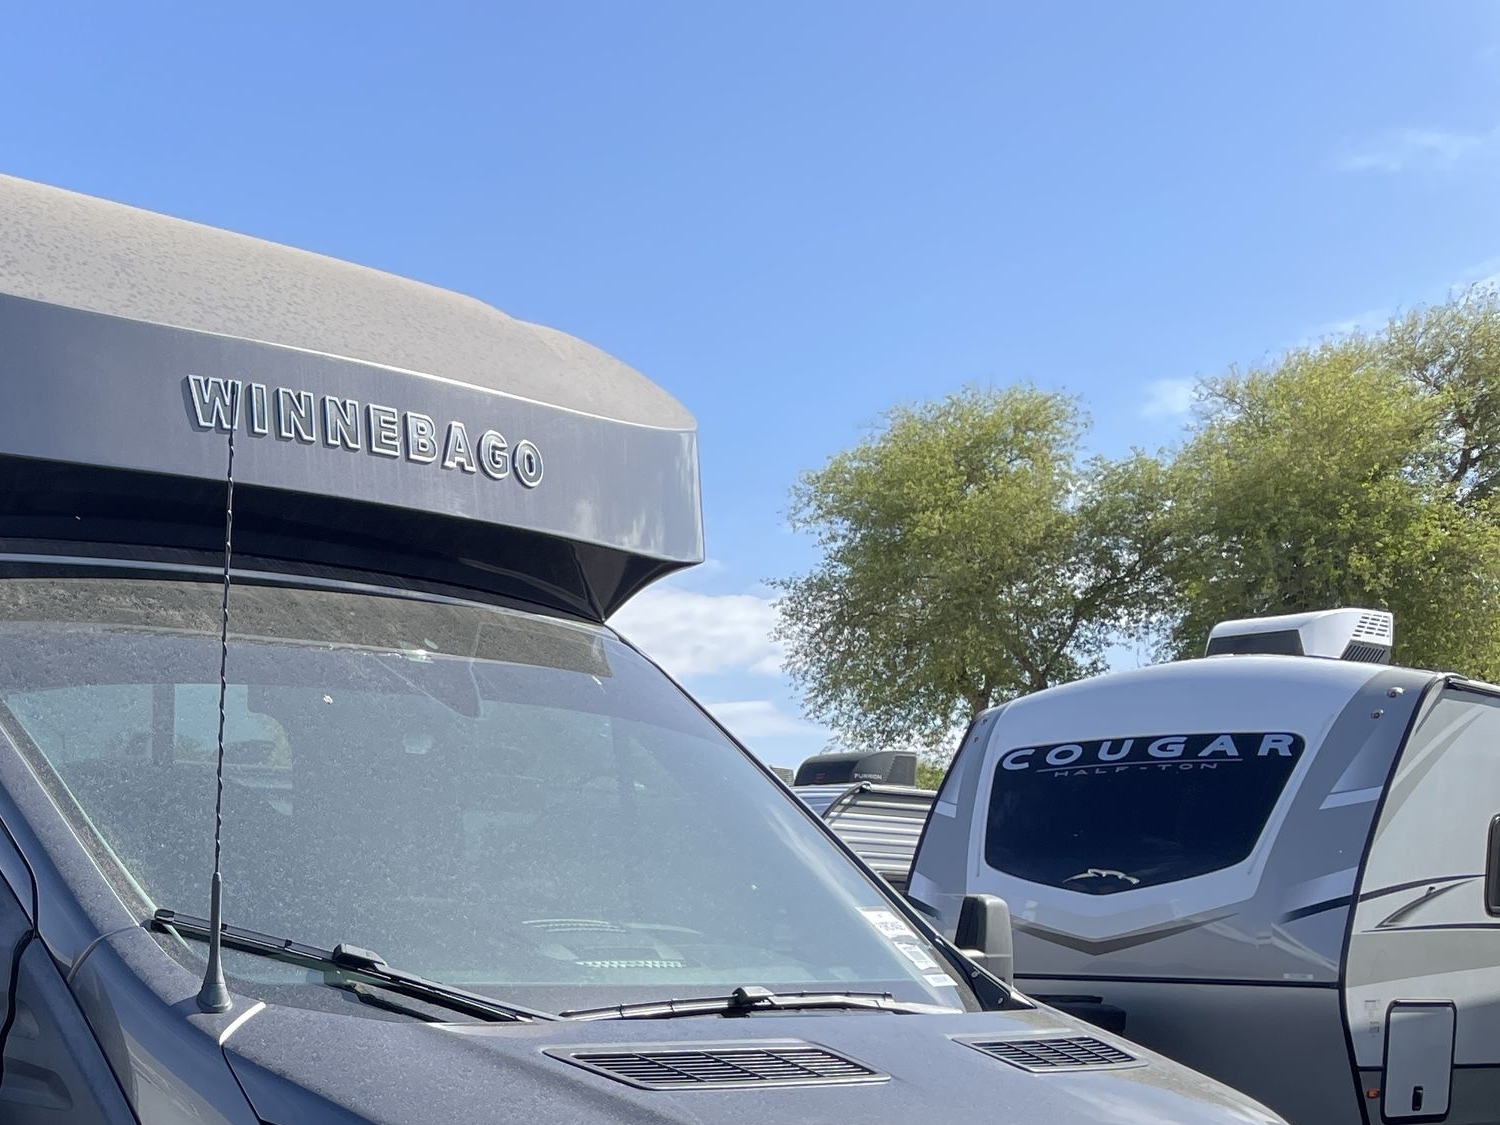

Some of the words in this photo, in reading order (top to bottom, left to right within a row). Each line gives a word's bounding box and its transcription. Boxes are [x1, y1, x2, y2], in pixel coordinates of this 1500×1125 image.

[184, 373, 544, 488] WINNEBAGO
[1001, 733, 1295, 771] COUGAR
[1053, 762, 1219, 778] HALF-TON
